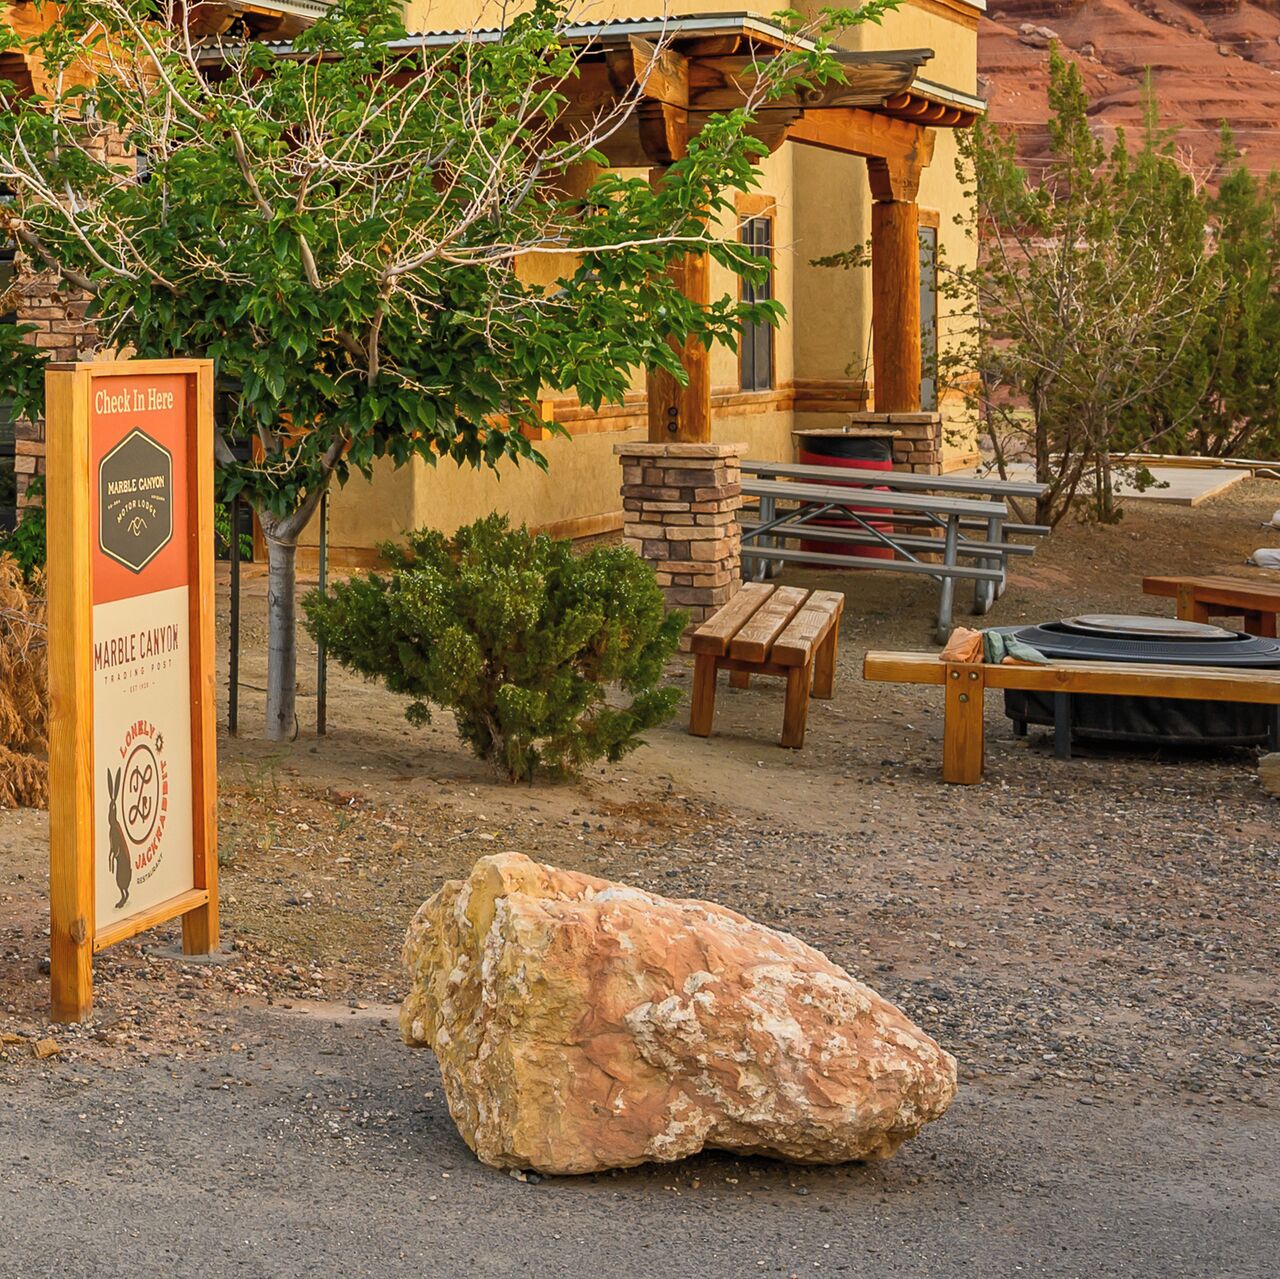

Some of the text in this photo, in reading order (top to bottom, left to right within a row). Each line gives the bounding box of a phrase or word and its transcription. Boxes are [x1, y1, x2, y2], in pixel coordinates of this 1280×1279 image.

[95, 387, 174, 415] Check In Here
[107, 475, 165, 495] MARBLE CANYON
[117, 500, 136, 523] MOTOR
[137, 500, 156, 518] LODGE
[94, 623, 178, 671] MARBLE CANYON
[104, 658, 172, 685] TRADING POST
[120, 720, 156, 759] LONELY
